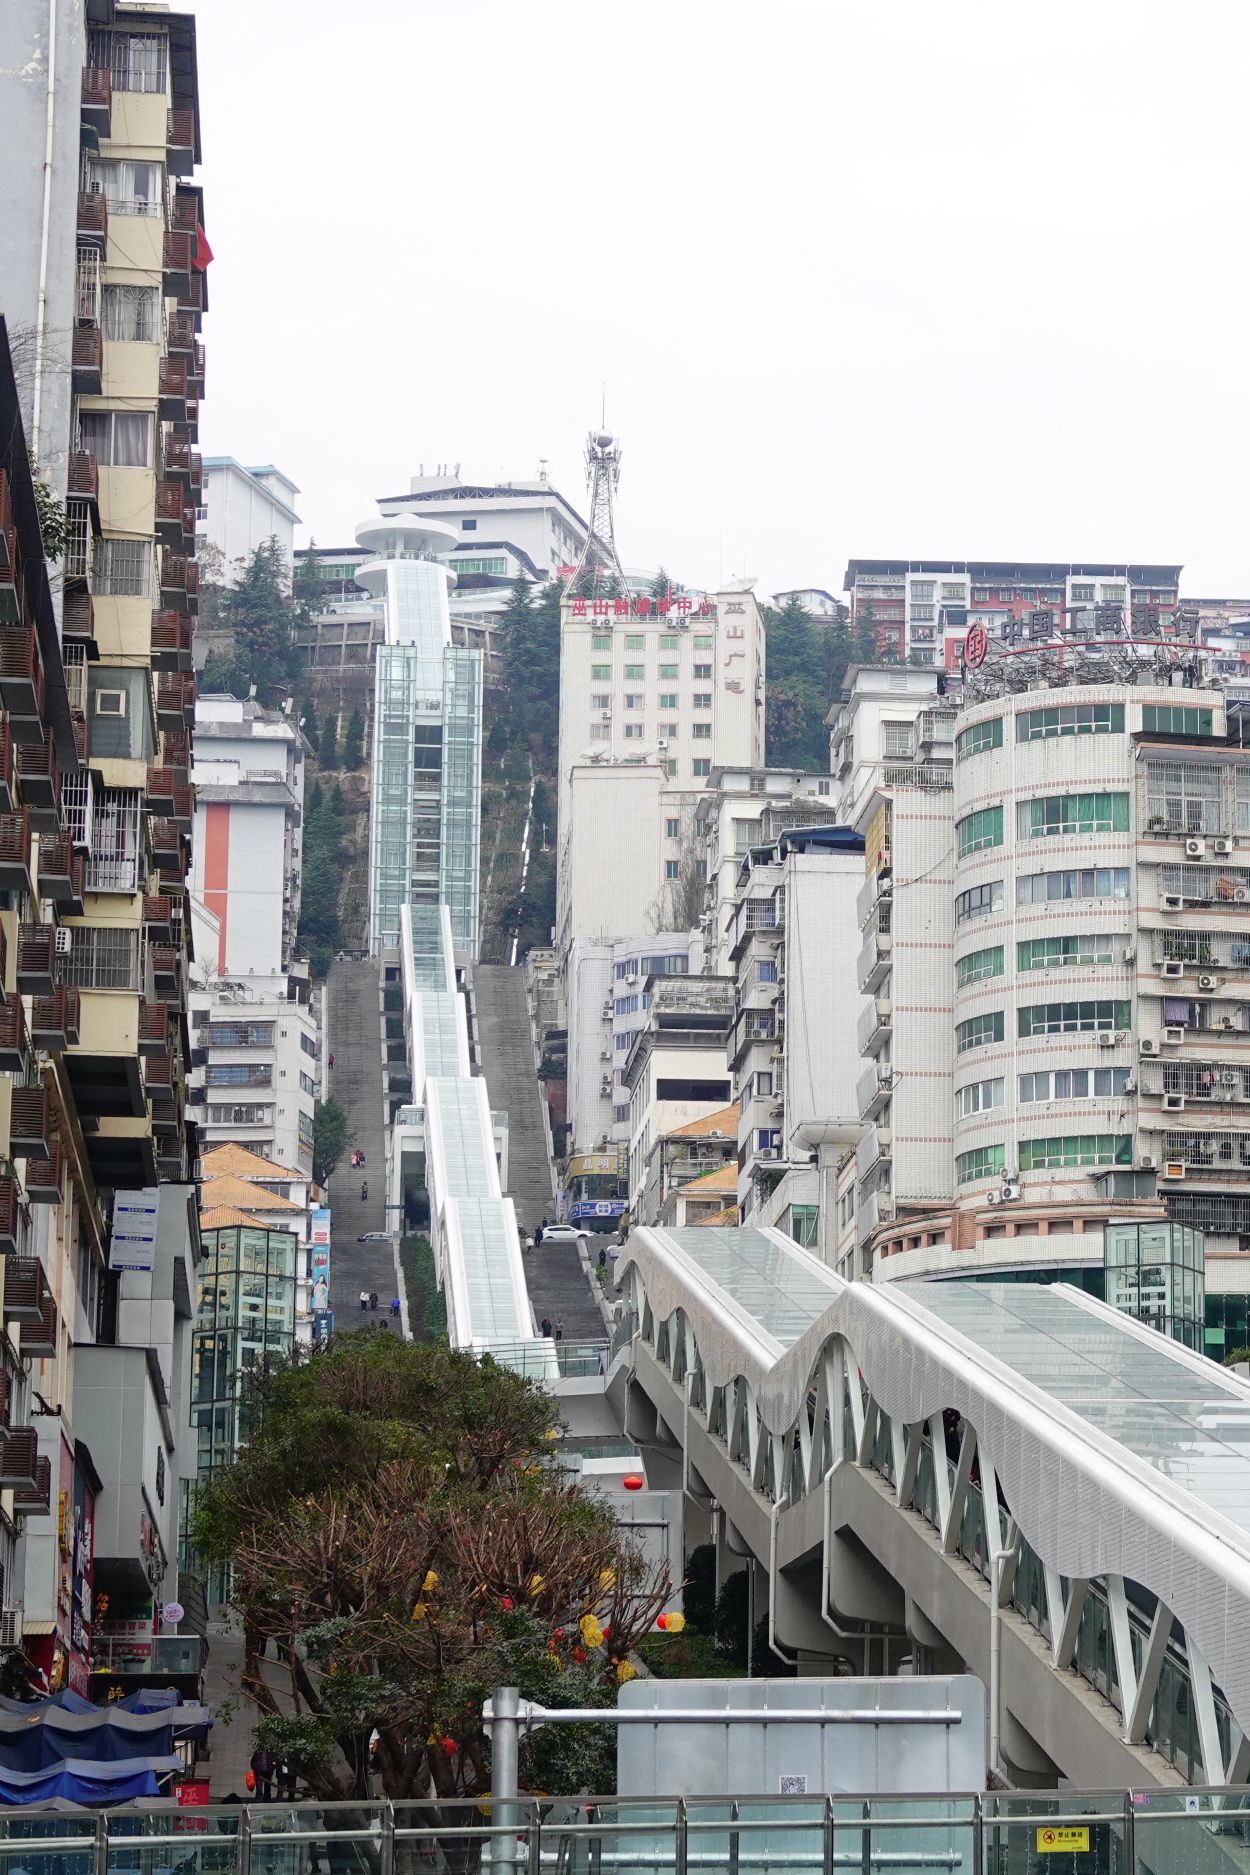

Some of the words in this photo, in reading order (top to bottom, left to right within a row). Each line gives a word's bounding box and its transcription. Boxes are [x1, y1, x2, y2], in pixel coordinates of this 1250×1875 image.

[724, 602, 746, 694] 巫山广电
[1001, 605, 1199, 646] 中国工商银行
